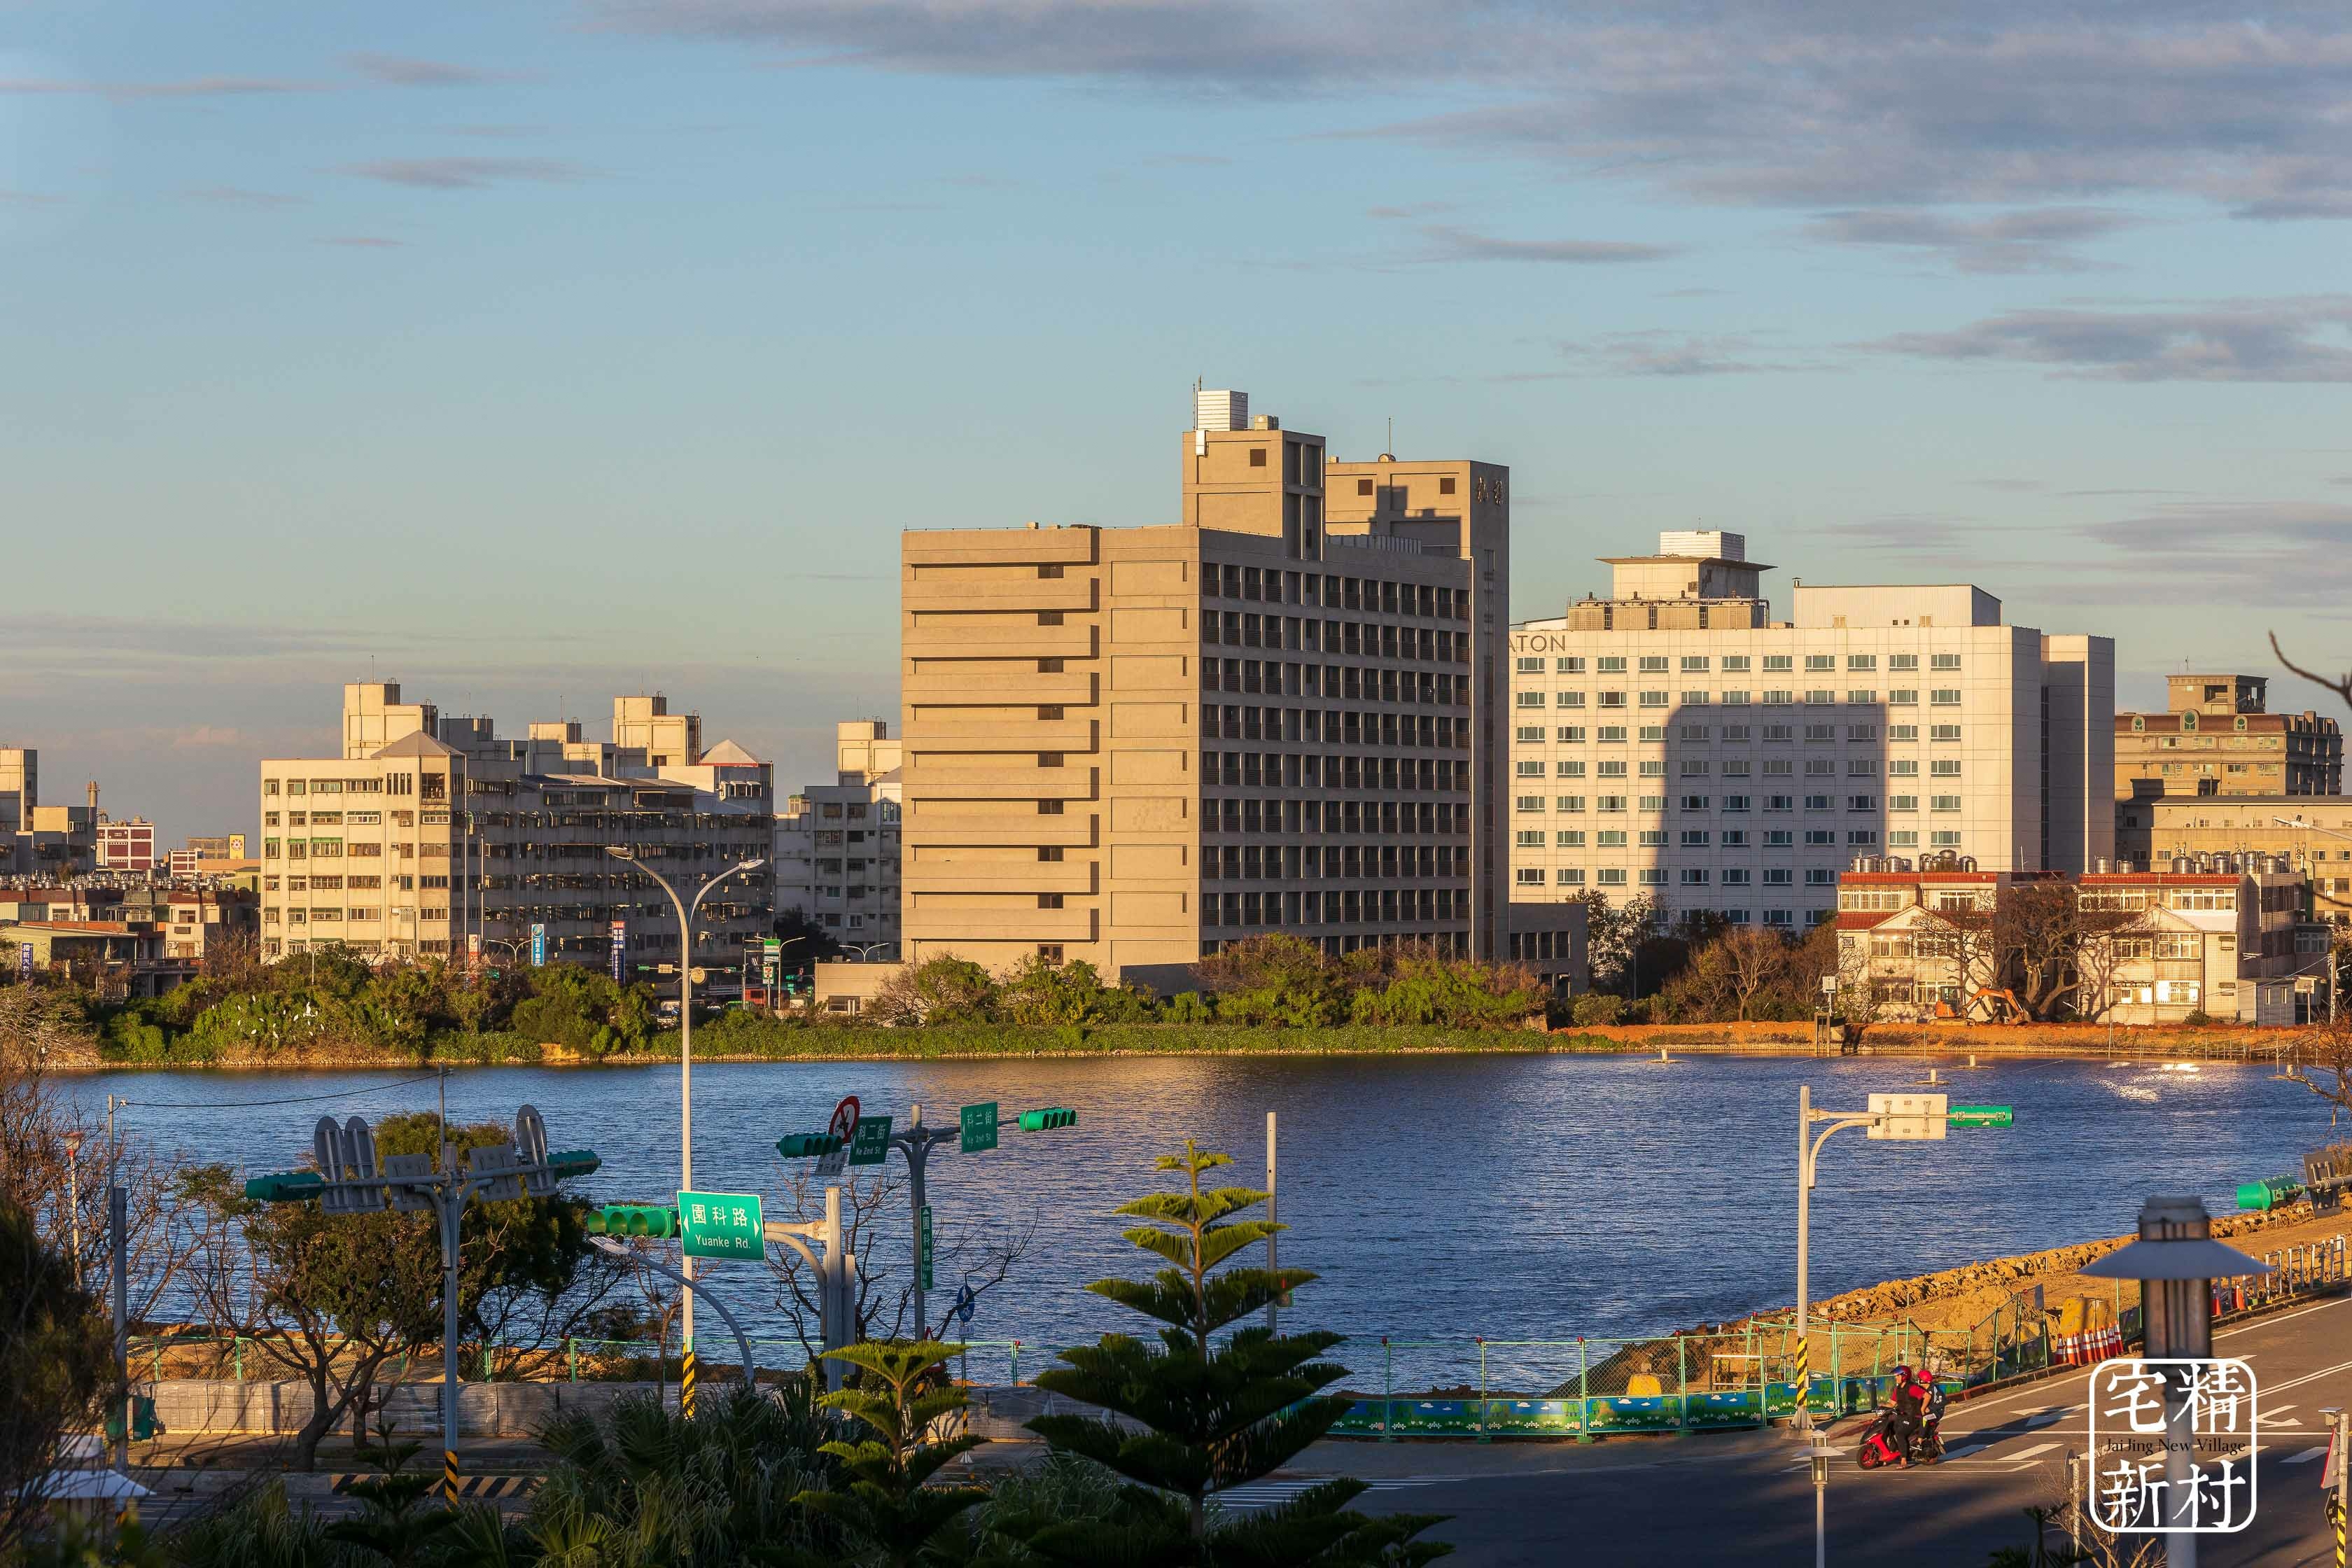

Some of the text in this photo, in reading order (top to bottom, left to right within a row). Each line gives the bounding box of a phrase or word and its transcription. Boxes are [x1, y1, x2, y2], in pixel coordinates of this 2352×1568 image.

[967, 1108, 991, 1128] 科二街
[858, 1124, 886, 1140] 科二街
[863, 1147, 874, 1155] 2nd
[692, 1204, 747, 1226] 園科路
[695, 1234, 751, 1249] Yuanke Rd.
